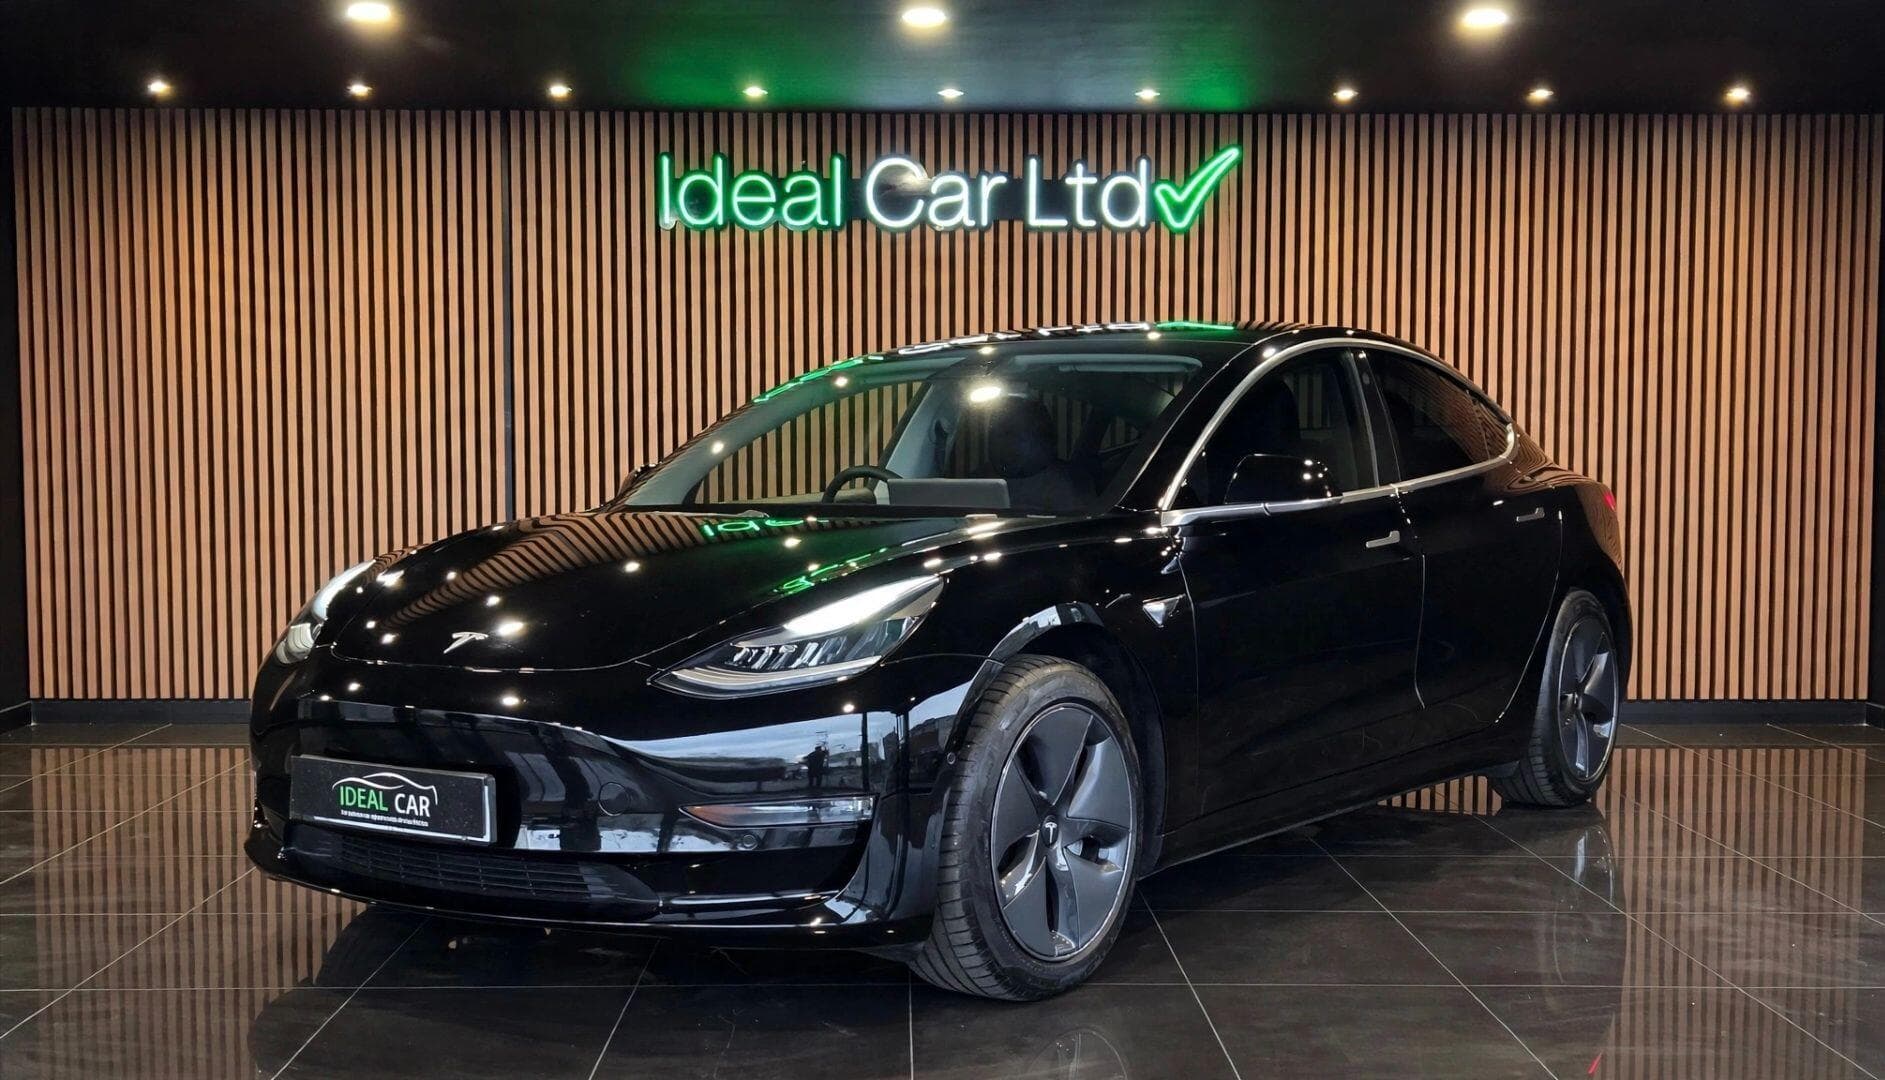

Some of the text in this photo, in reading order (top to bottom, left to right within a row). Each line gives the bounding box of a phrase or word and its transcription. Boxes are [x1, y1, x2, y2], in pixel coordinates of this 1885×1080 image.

[659, 153, 1149, 229] Ideal Car Ltd
[340, 786, 430, 817] IDEAL CAR
